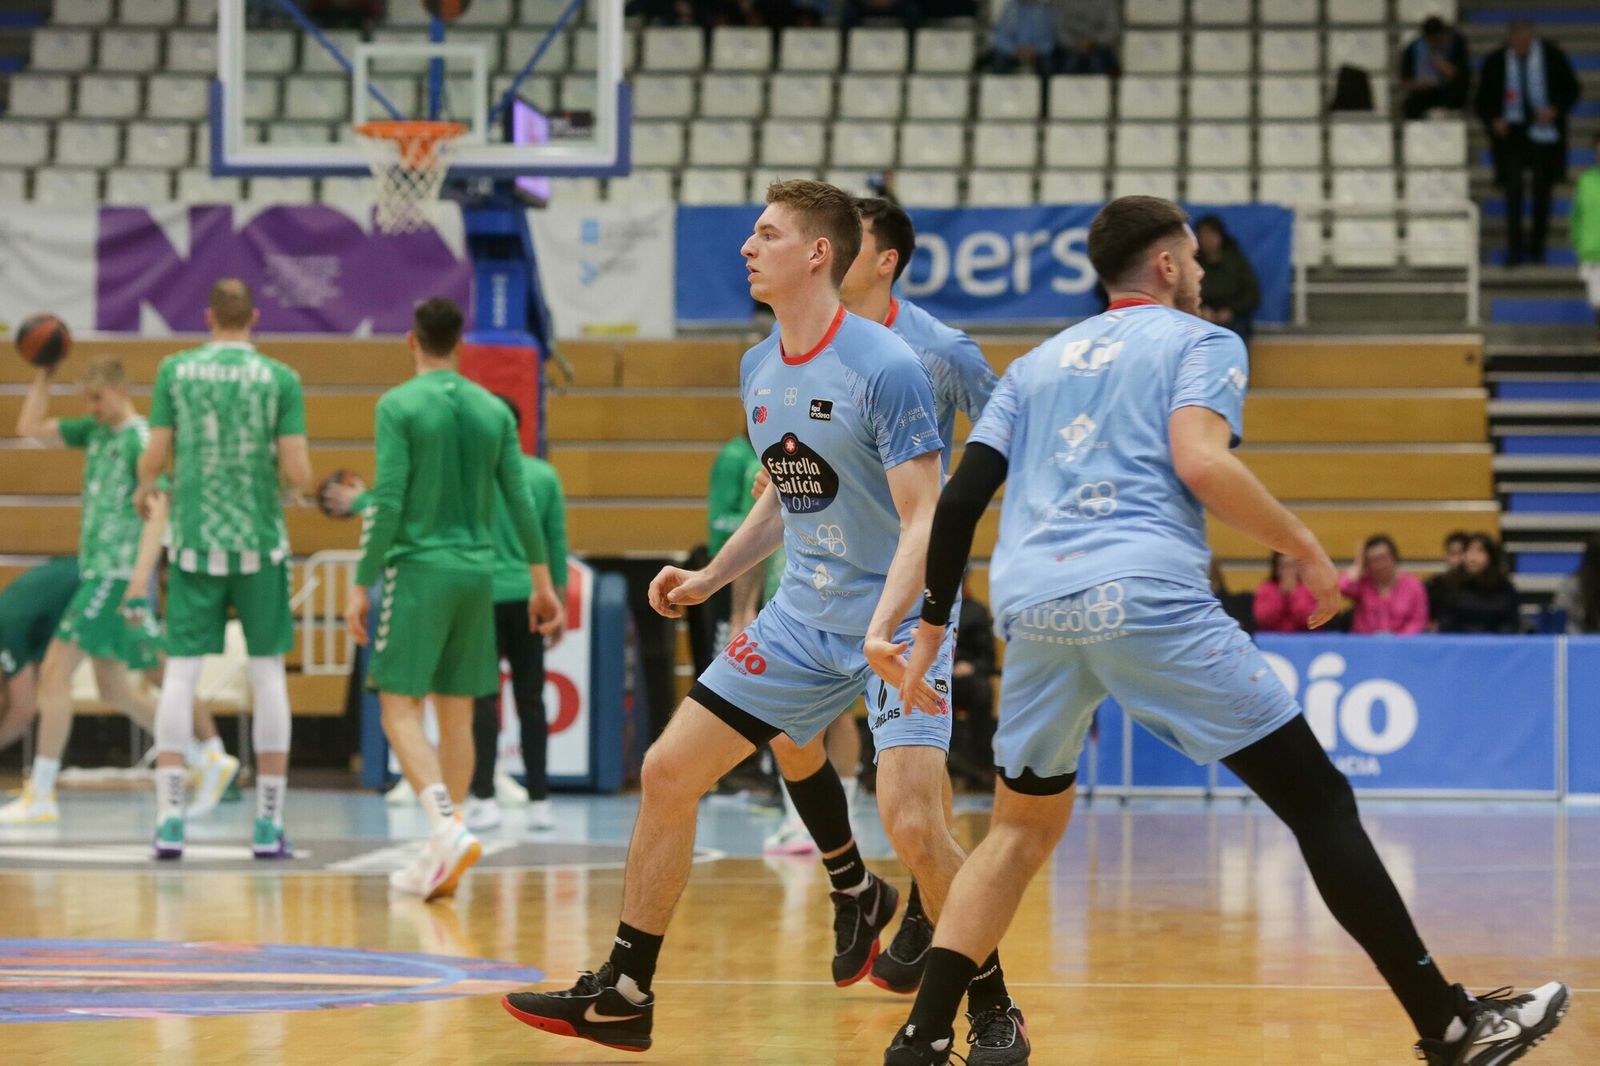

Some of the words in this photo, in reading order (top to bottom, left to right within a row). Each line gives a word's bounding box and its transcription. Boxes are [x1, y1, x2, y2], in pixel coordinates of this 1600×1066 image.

[766, 456, 821, 476] Estrella
[776, 474, 823, 495] Galicia
[1021, 608, 1084, 632] LUGO
[1262, 651, 1419, 755] ío
